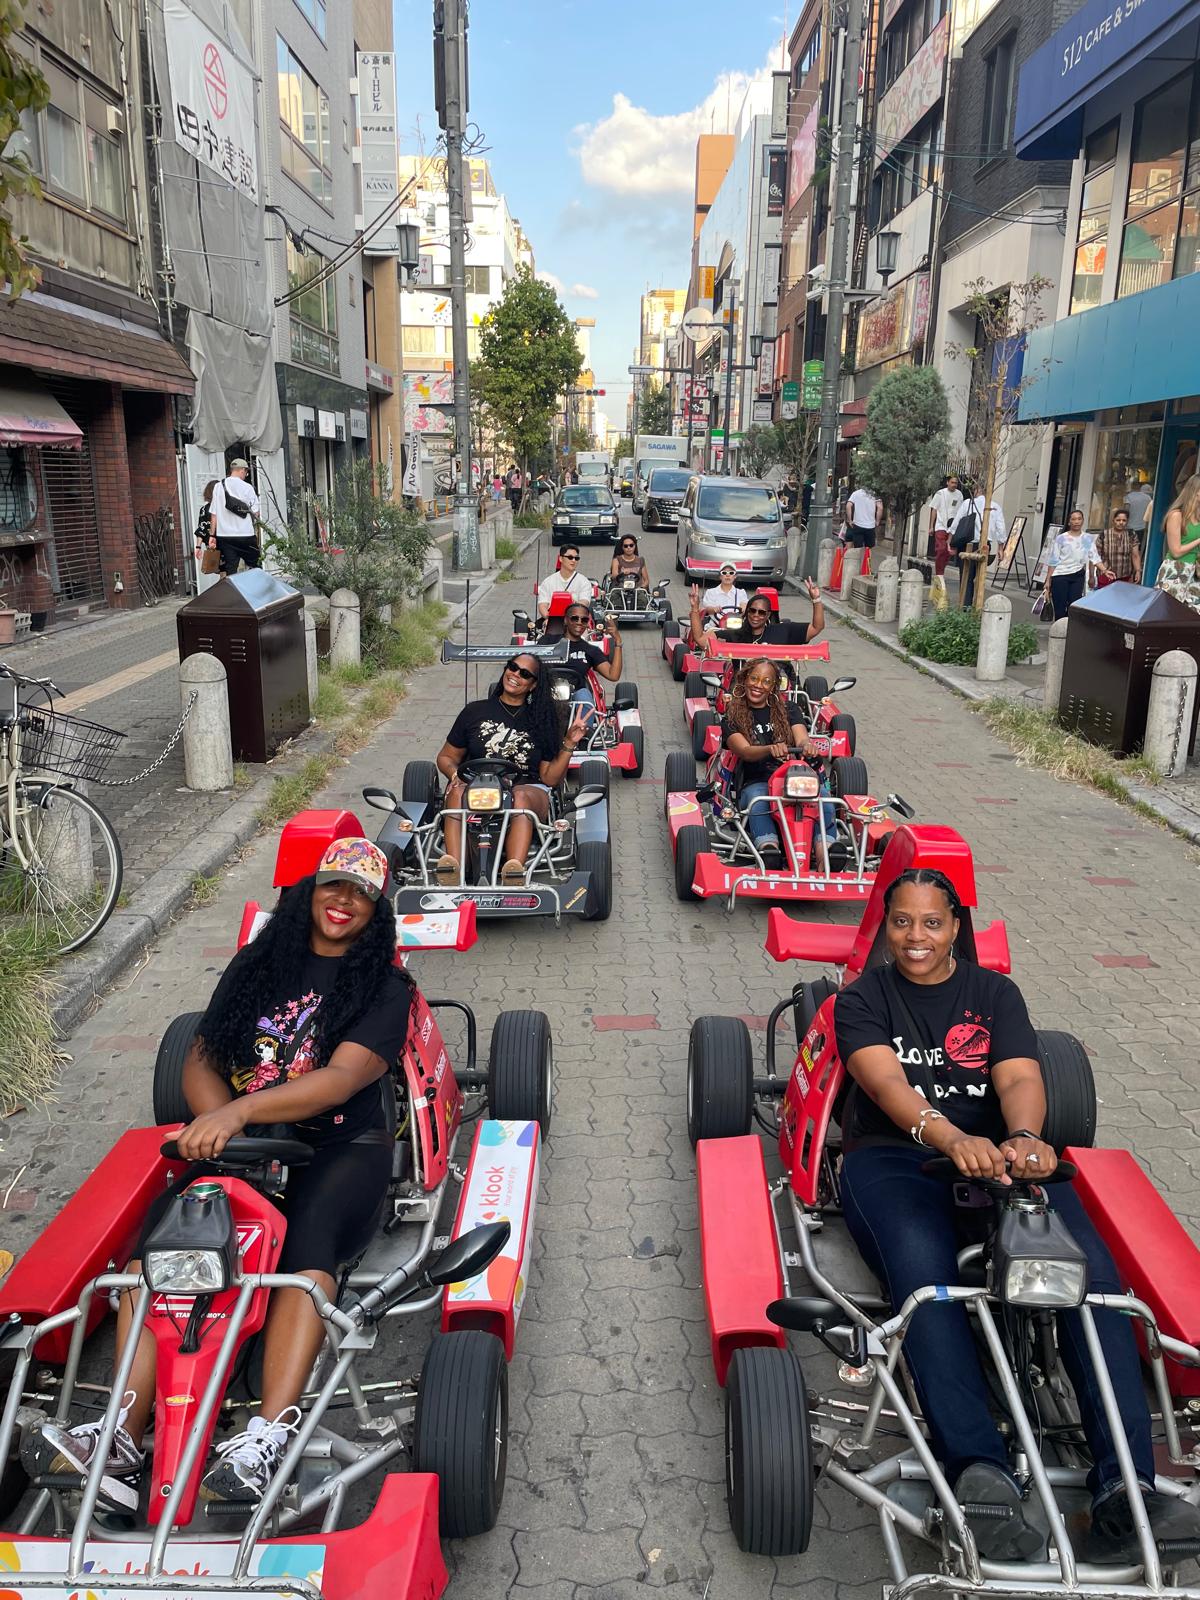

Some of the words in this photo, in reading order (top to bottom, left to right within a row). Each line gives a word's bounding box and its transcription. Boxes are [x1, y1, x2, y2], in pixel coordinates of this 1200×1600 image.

[1061, 35, 1083, 76] 512
[1084, 15, 1113, 52] CAFE
[1113, 7, 1123, 28] &
[177, 102, 257, 195] 田中建設
[366, 182, 394, 190] KANNA
[647, 443, 677, 451] SAGAWA
[893, 1036, 944, 1066] LOVE
[478, 1166, 505, 1206] klook
